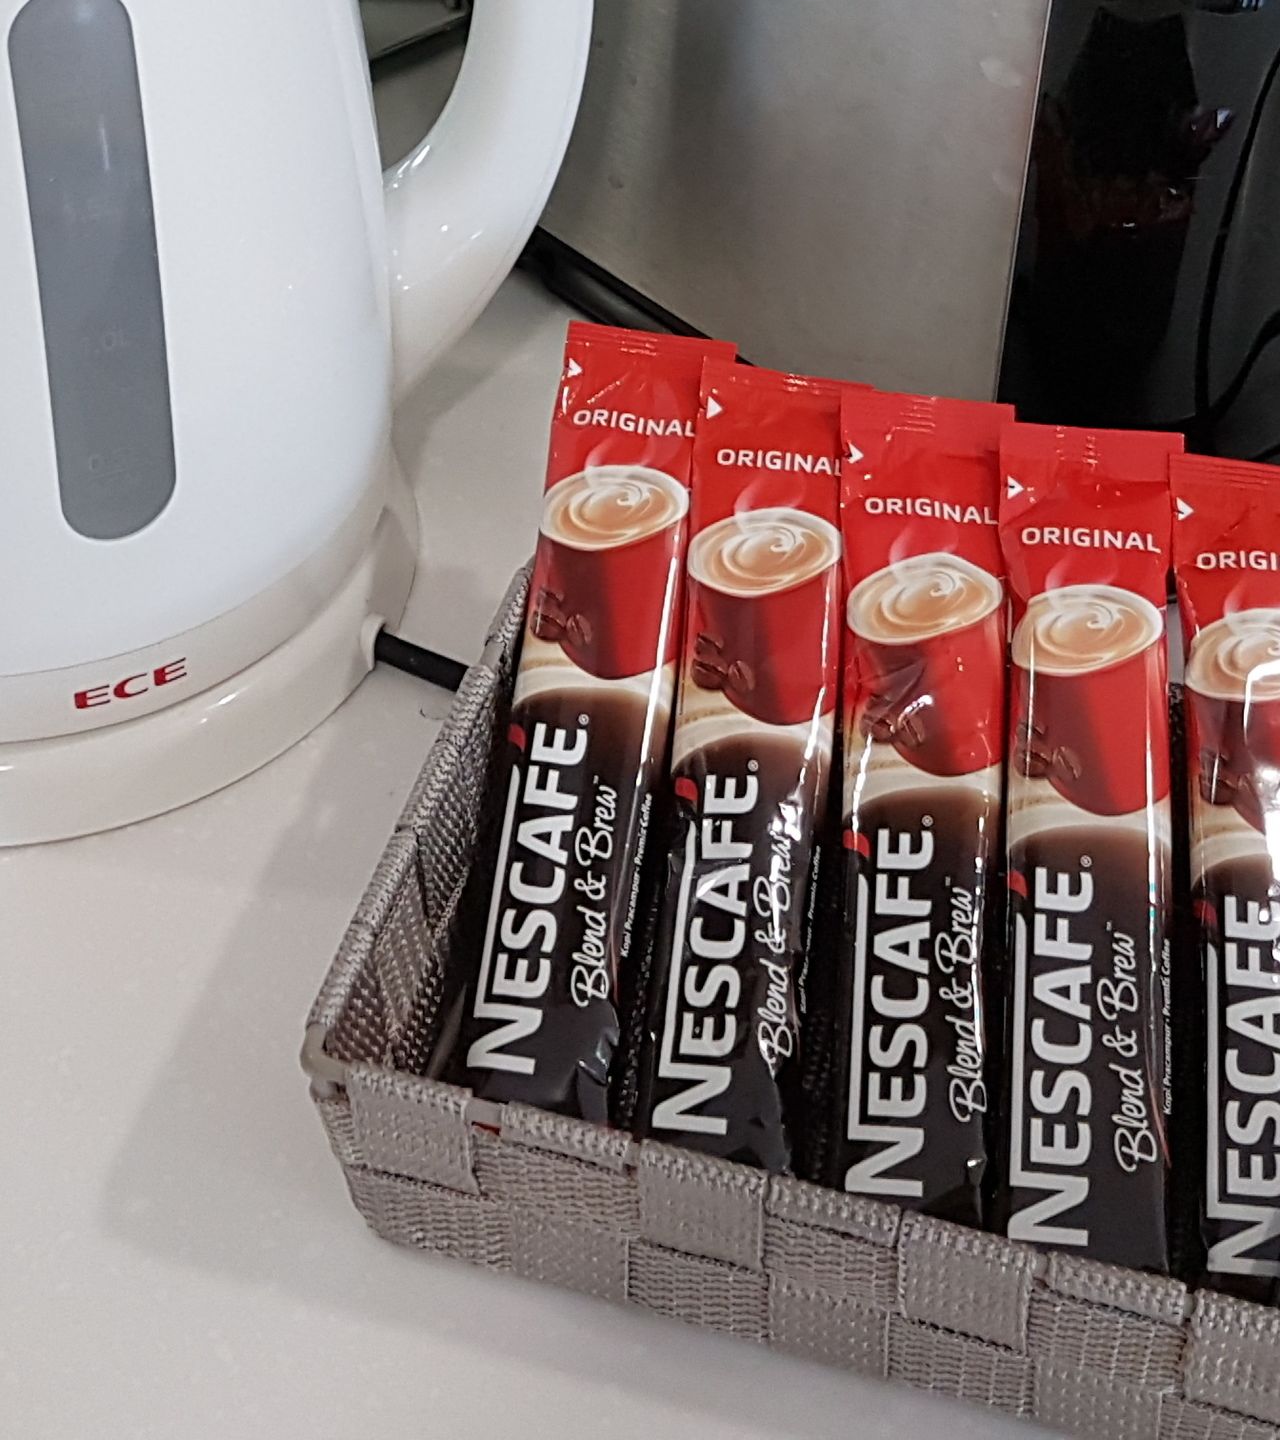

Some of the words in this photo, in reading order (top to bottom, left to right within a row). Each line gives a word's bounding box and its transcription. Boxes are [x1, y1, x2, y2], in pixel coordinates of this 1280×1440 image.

[572, 408, 696, 438] ORIGINAL
[716, 448, 842, 477] ORIGINAL
[864, 496, 1000, 525] ORIGINAL
[1020, 526, 1162, 554] ORIGINAL
[73, 656, 188, 710] ECE
[574, 784, 618, 867] Brew
[639, 792, 653, 828] Coffee
[573, 870, 607, 901] &
[752, 829, 792, 918] Brew
[754, 921, 787, 954] &
[934, 886, 973, 975] Brew
[570, 904, 610, 1008] Blend
[1096, 932, 1139, 1021] Brew
[756, 957, 793, 1063] Blend
[938, 977, 973, 1009] &
[1101, 1024, 1138, 1058] &
[944, 1013, 988, 1123] Blend
[1108, 1062, 1158, 1173] Blend
